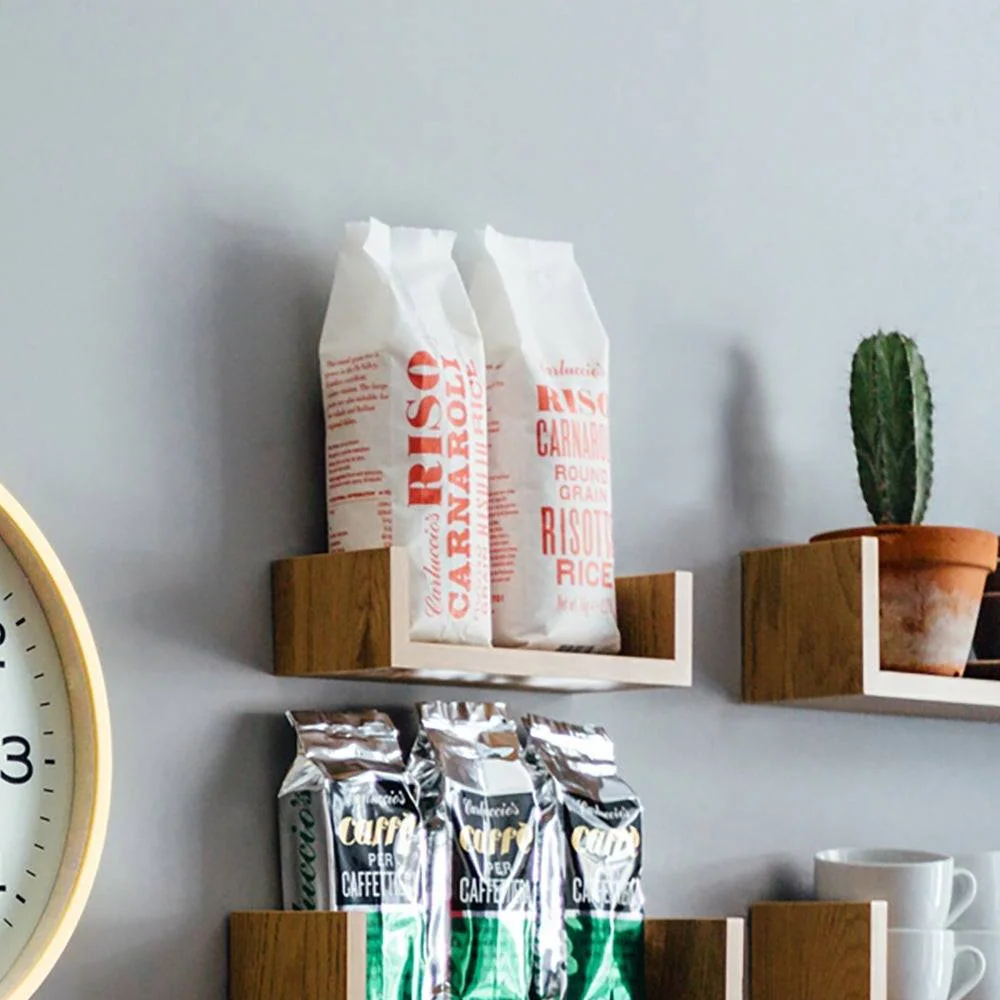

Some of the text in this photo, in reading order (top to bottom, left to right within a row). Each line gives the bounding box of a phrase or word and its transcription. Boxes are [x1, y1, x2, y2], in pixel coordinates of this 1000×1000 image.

[406, 350, 443, 507] RISO
[441, 355, 471, 619] CARNAROLI
[559, 484, 607, 504] GRAIN
[556, 558, 614, 589] RICE
[0, 735, 34, 784] 3
[367, 852, 394, 868] PER
